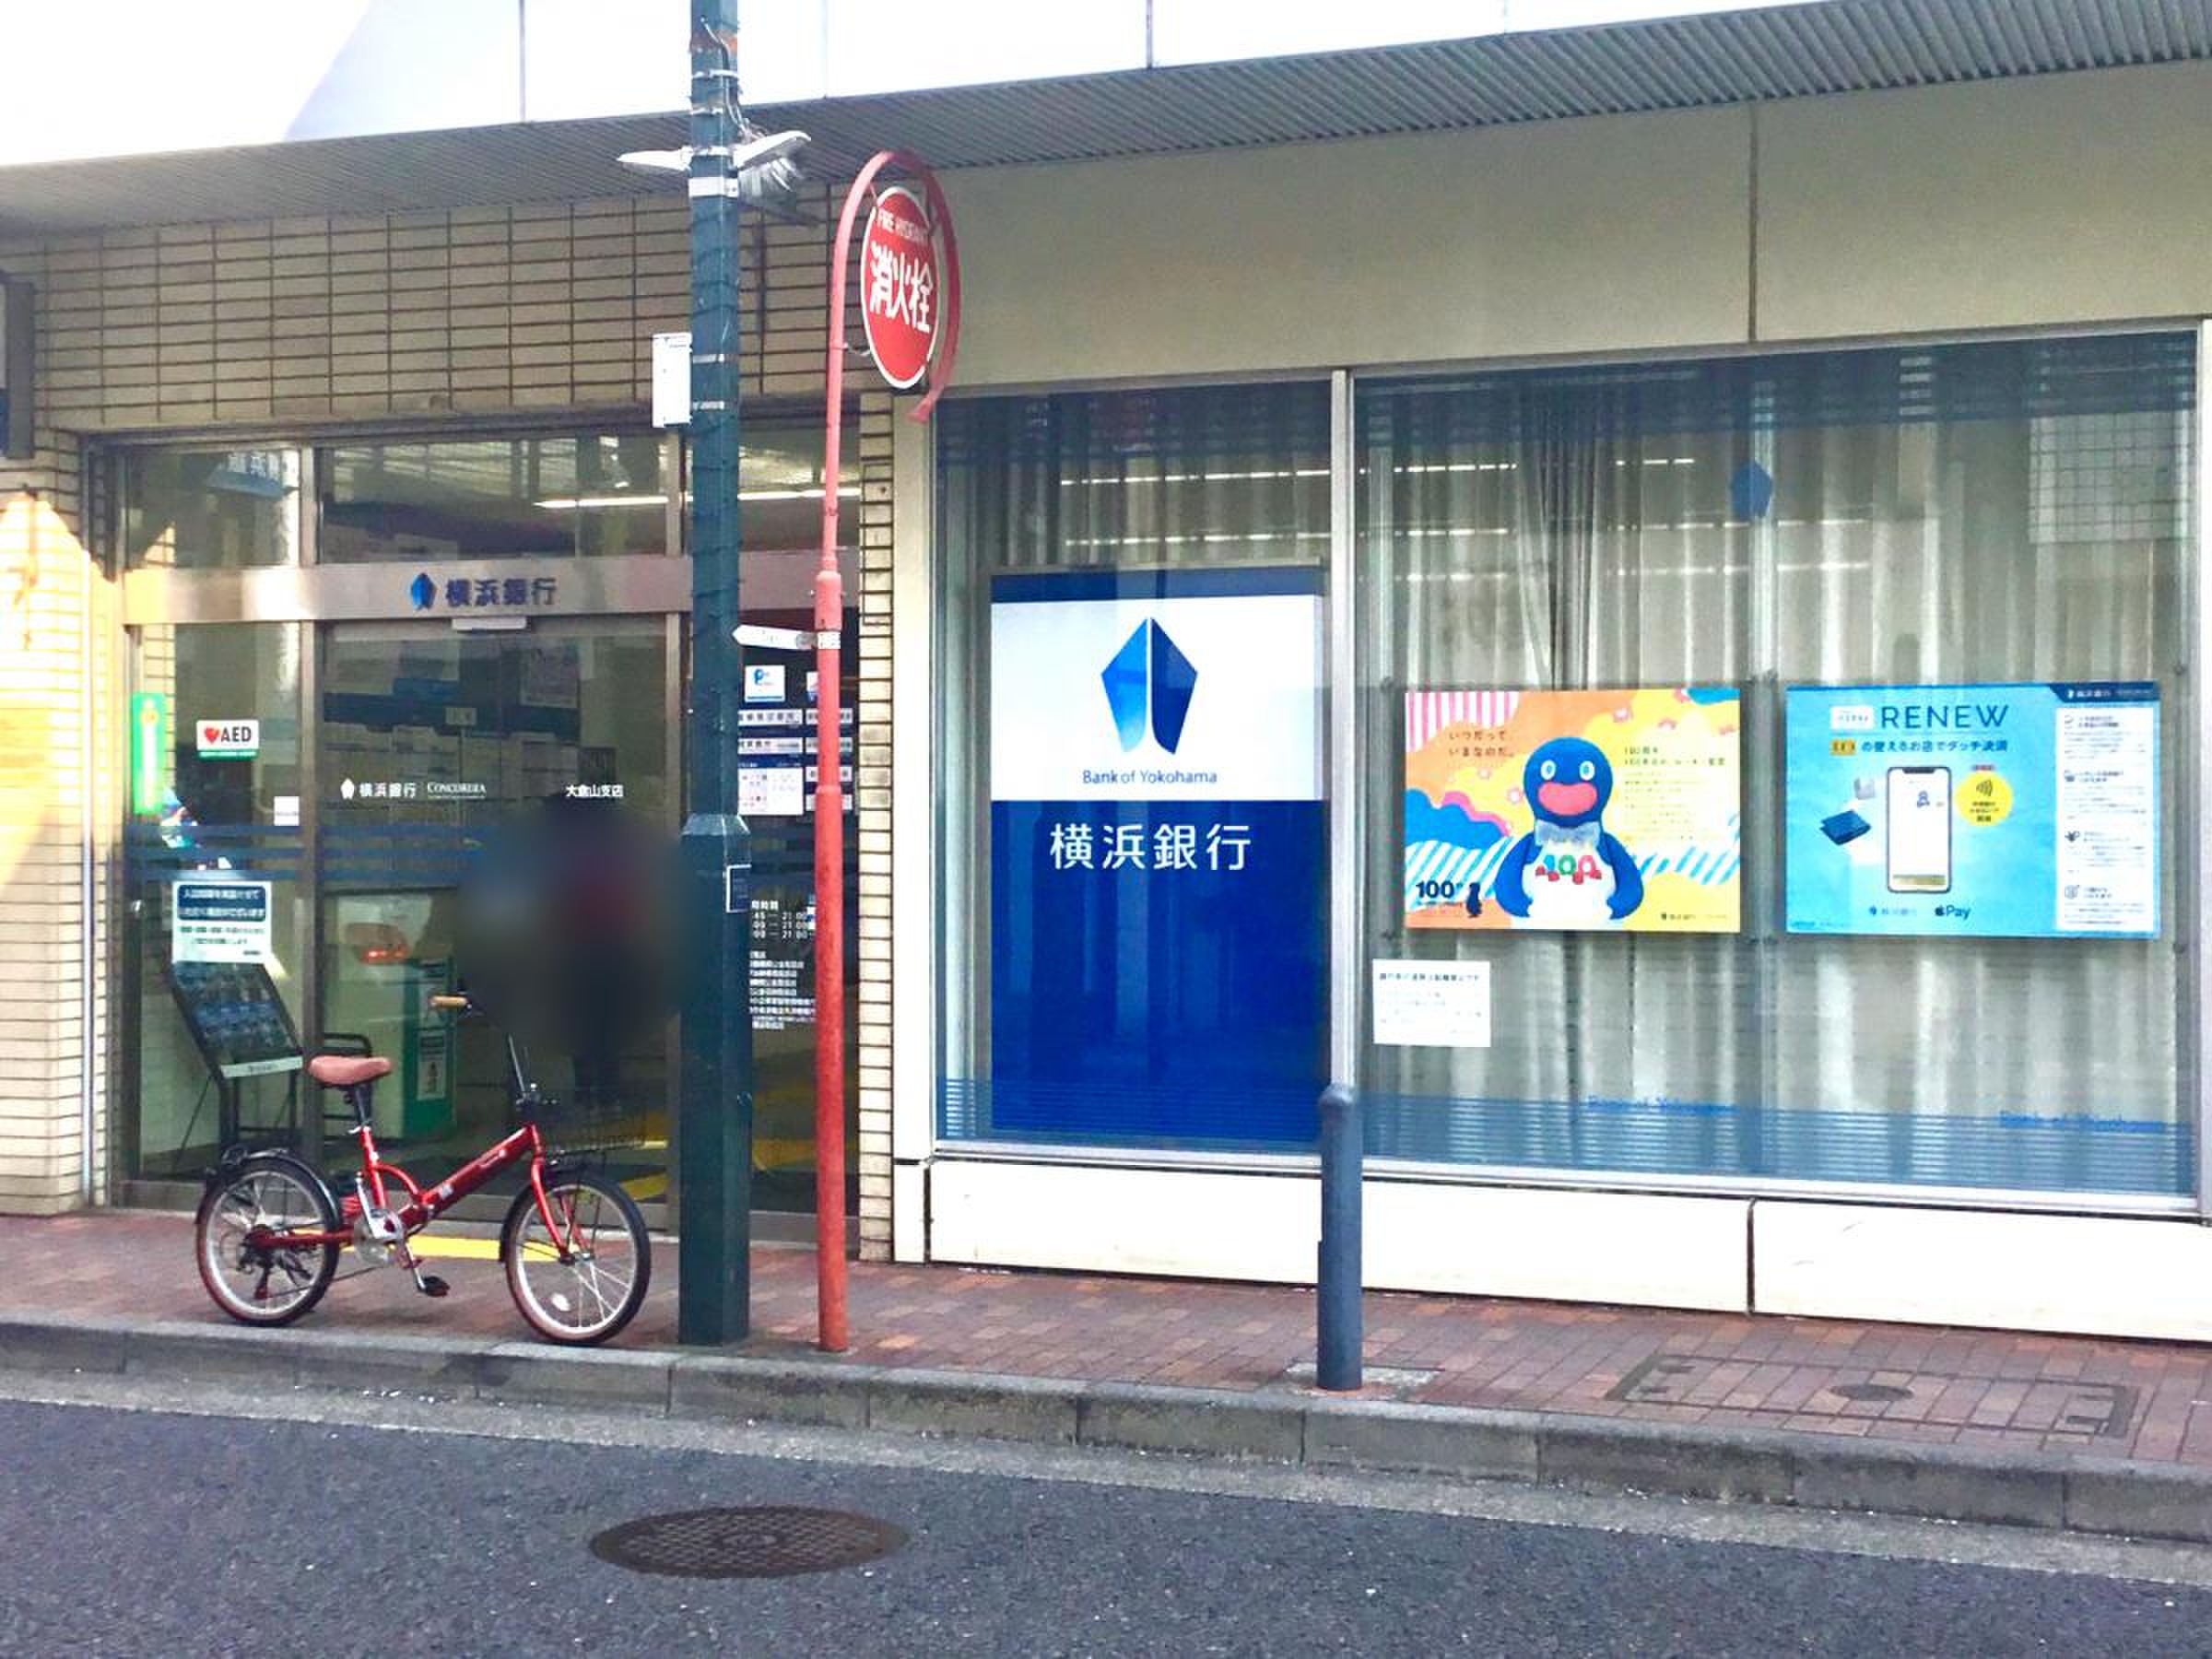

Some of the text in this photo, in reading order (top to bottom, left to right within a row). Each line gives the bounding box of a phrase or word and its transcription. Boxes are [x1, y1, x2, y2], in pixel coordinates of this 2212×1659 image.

[869, 240, 933, 334] 消火栓
[446, 577, 557, 607] 横浜銀行
[1881, 705, 2009, 729] RENEW
[220, 725, 253, 743] AED
[1082, 769, 1218, 784] Bank of Yokohama
[359, 782, 417, 797] 横浜銀行
[1049, 822, 1252, 871] 横浜銀行
[1946, 904, 1972, 921] Pay
